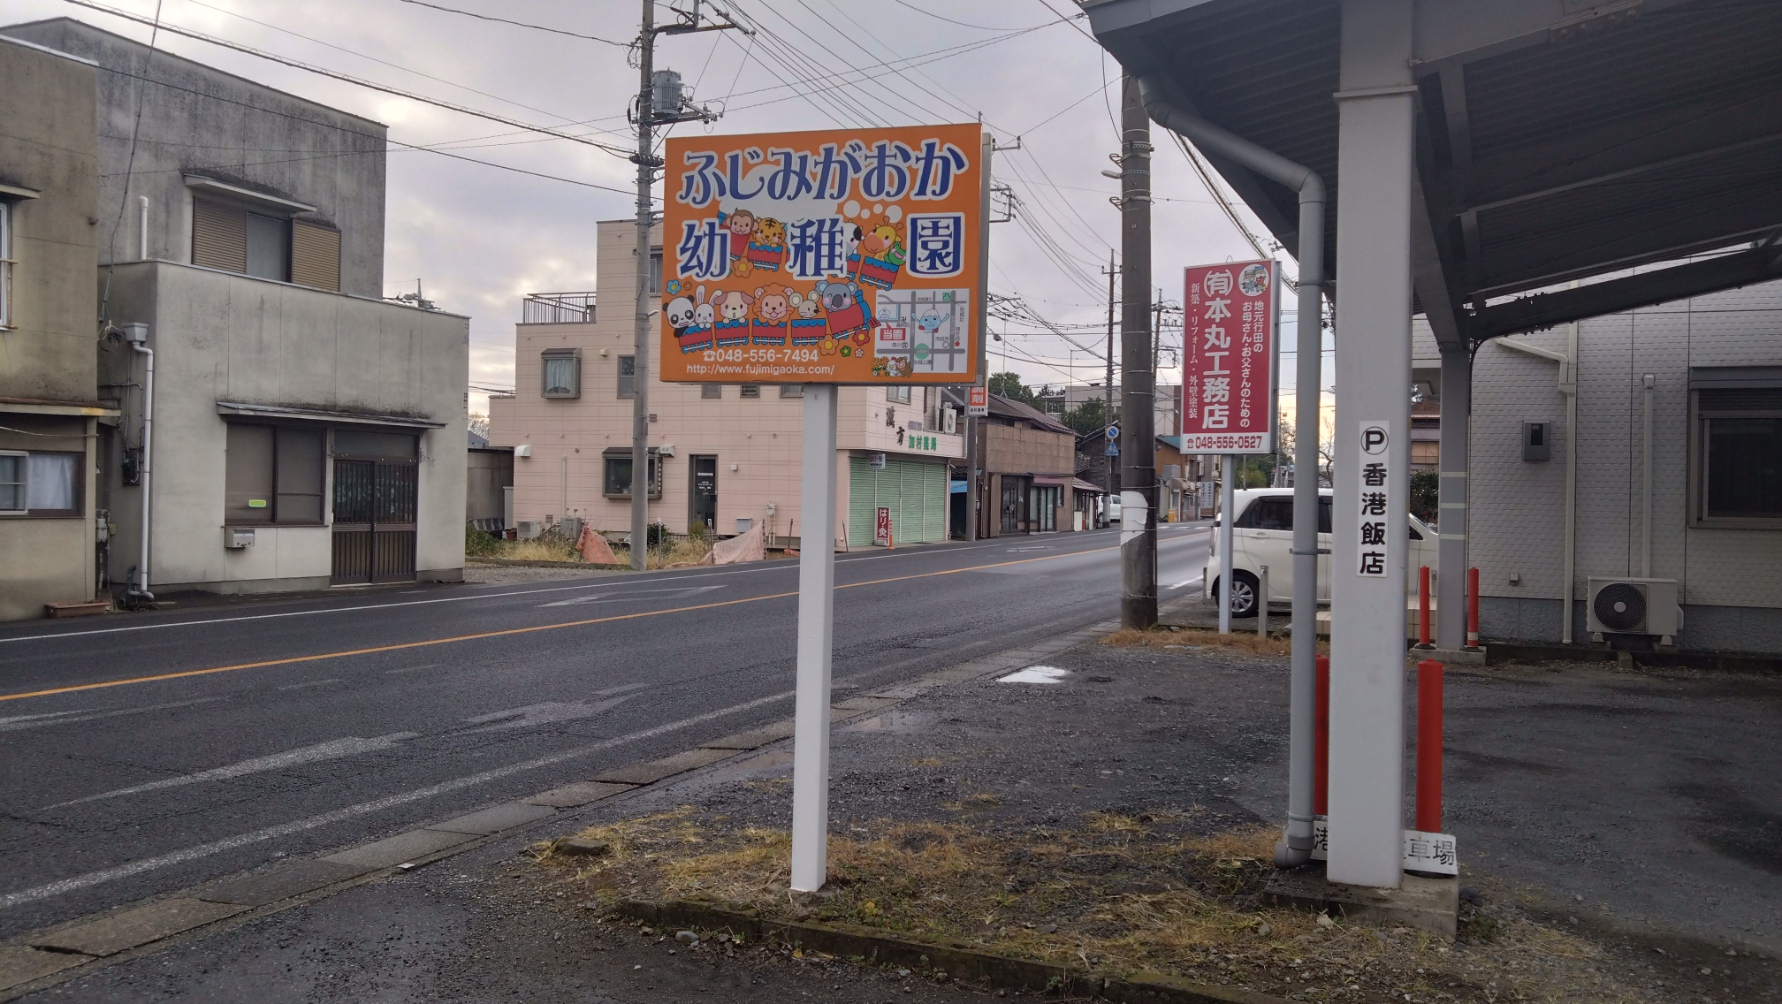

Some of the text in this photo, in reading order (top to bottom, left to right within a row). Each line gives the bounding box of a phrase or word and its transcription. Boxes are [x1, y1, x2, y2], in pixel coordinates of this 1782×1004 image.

[678, 141, 967, 207] ふじみがおか
[677, 215, 962, 278] 幼稚園
[1188, 282, 1200, 419] 新築・リフォーム・外壁塗装
[1253, 300, 1265, 353] 地元行田の
[686, 364, 835, 375] http://www.fujimigaoka.com/
[717, 350, 819, 362] 048-556-7494
[1240, 301, 1252, 428] お母さん・お父さんのための
[1195, 435, 1263, 449] 048-556-0527
[1360, 462, 1387, 575] 香港飯店
[1404, 838, 1455, 866] 車場
